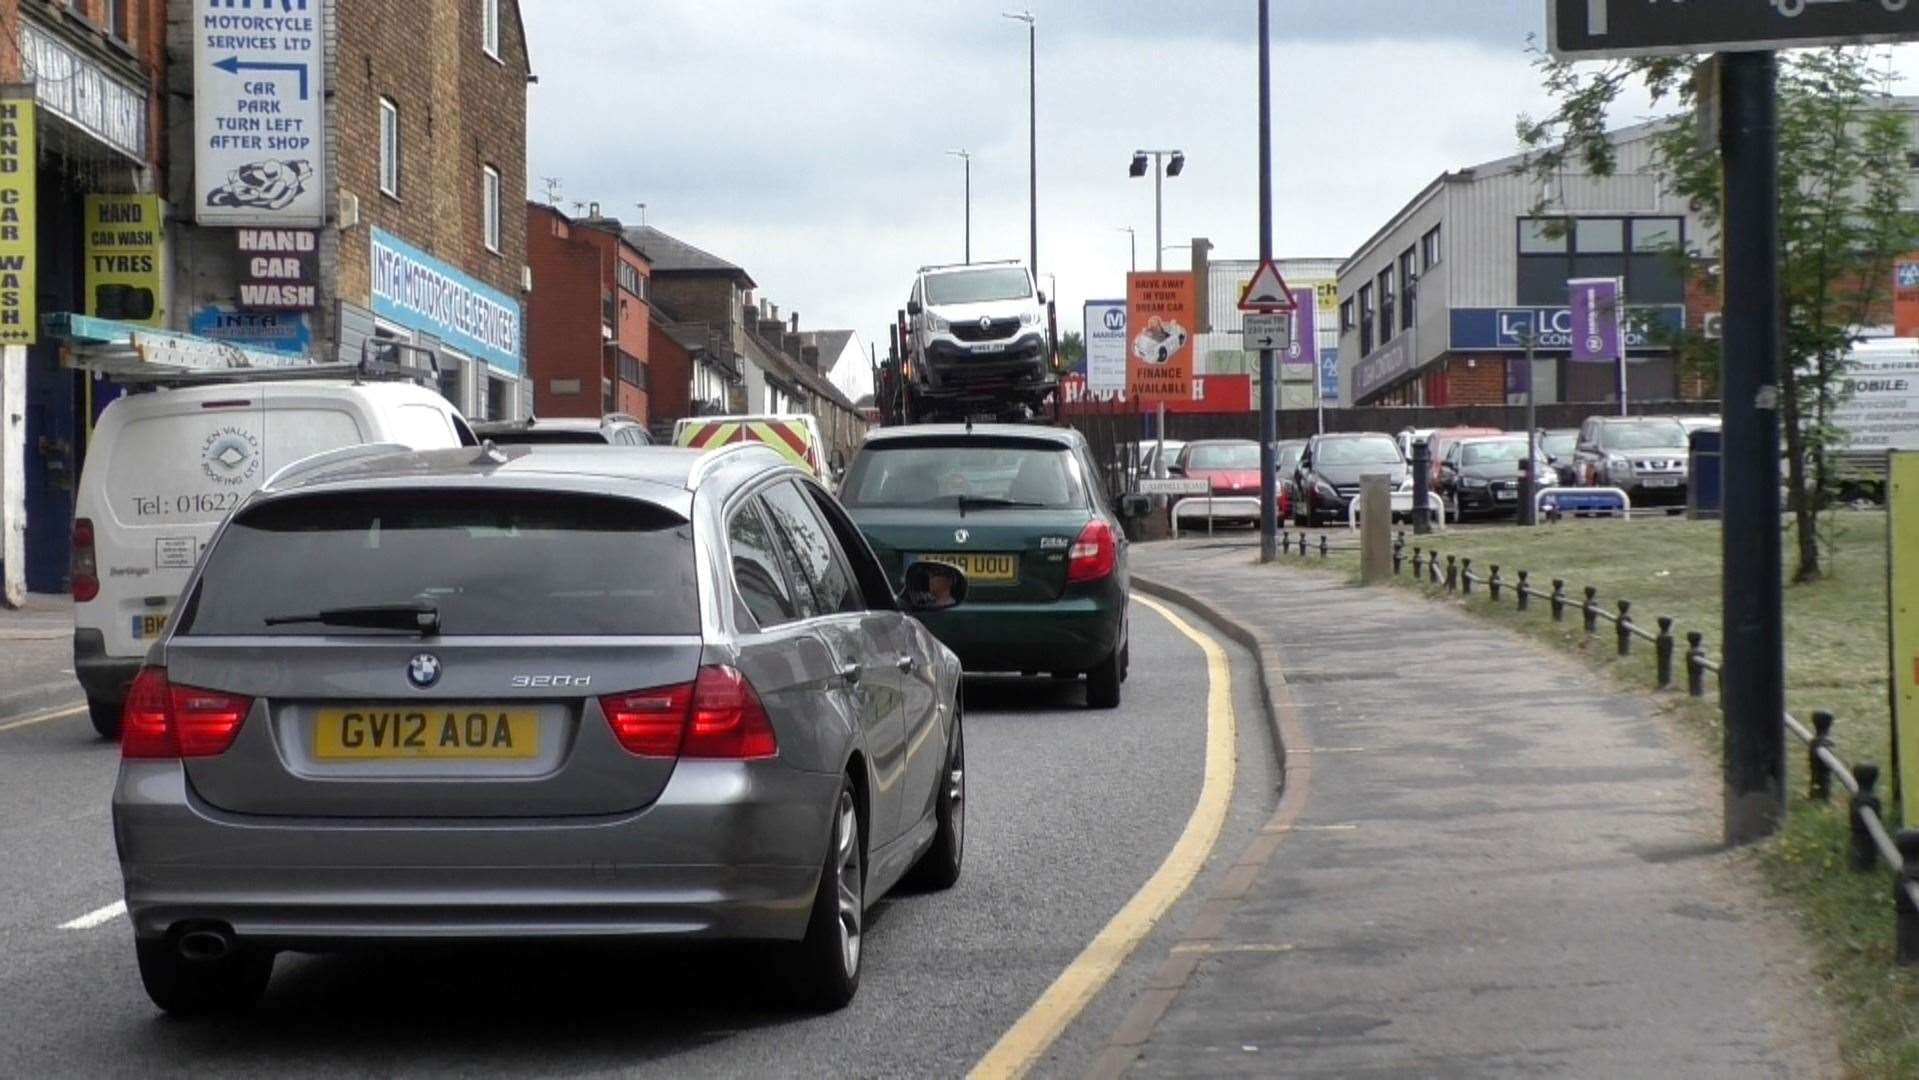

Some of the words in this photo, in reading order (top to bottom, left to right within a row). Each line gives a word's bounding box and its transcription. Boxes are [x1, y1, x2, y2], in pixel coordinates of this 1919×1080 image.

[204, 15, 312, 31] MOTORCYCLE
[207, 35, 277, 50] SERVICES
[284, 38, 312, 50] LTD
[244, 81, 276, 96] CAR
[237, 99, 281, 114] PARK
[216, 117, 260, 132] TURN
[266, 119, 303, 132] LEFT
[0, 104, 18, 173] HAND
[209, 135, 262, 150] AFTER
[268, 137, 310, 150] SHOP
[0, 188, 19, 240] CAR
[99, 203, 142, 223] HAND
[91, 231, 116, 246] CAR
[118, 231, 153, 246] WASH
[239, 230, 315, 250] HAND
[93, 255, 153, 273] TYRES
[251, 257, 301, 279] CAR
[0, 255, 25, 324] WASH
[1162, 280, 1184, 289] AWAY
[241, 285, 315, 306] WASH
[401, 257, 471, 336] MOTORCYCLE
[472, 292, 514, 356] SERVICES
[1137, 368, 1182, 379] FINANCE
[1131, 384, 1187, 394] AVAILABLE
[133, 496, 169, 515] Tel:
[511, 675, 591, 687] 320d
[341, 713, 426, 748] GV12
[439, 713, 513, 748] AOA
